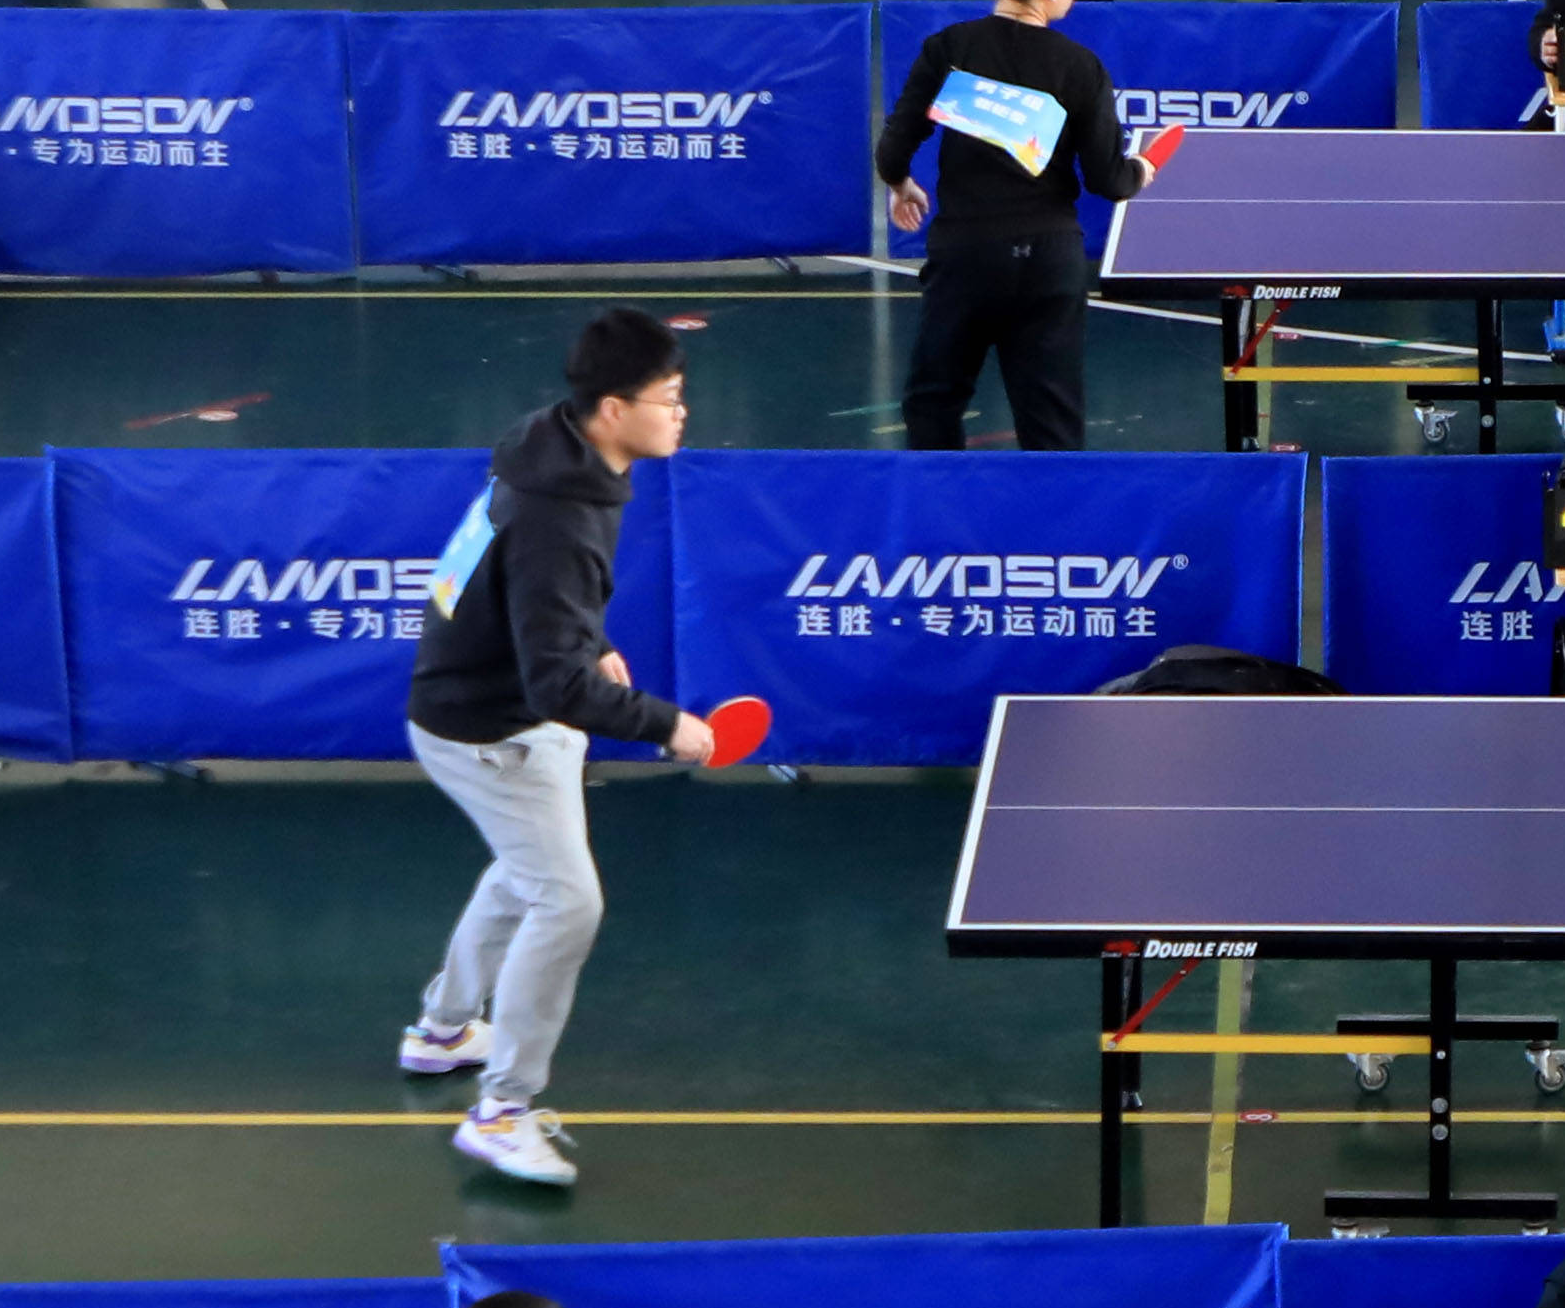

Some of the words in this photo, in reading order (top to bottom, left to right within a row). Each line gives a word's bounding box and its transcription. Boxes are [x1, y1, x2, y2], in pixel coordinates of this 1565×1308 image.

[1118, 89, 1294, 126] DSON
[1253, 284, 1309, 299] DOUBLE
[1310, 287, 1341, 299] FISH
[171, 558, 438, 602] LANDS
[183, 606, 426, 640] 连胜·专为运
[1143, 939, 1216, 958] DOUBLE
[1217, 942, 1258, 958] FISH
